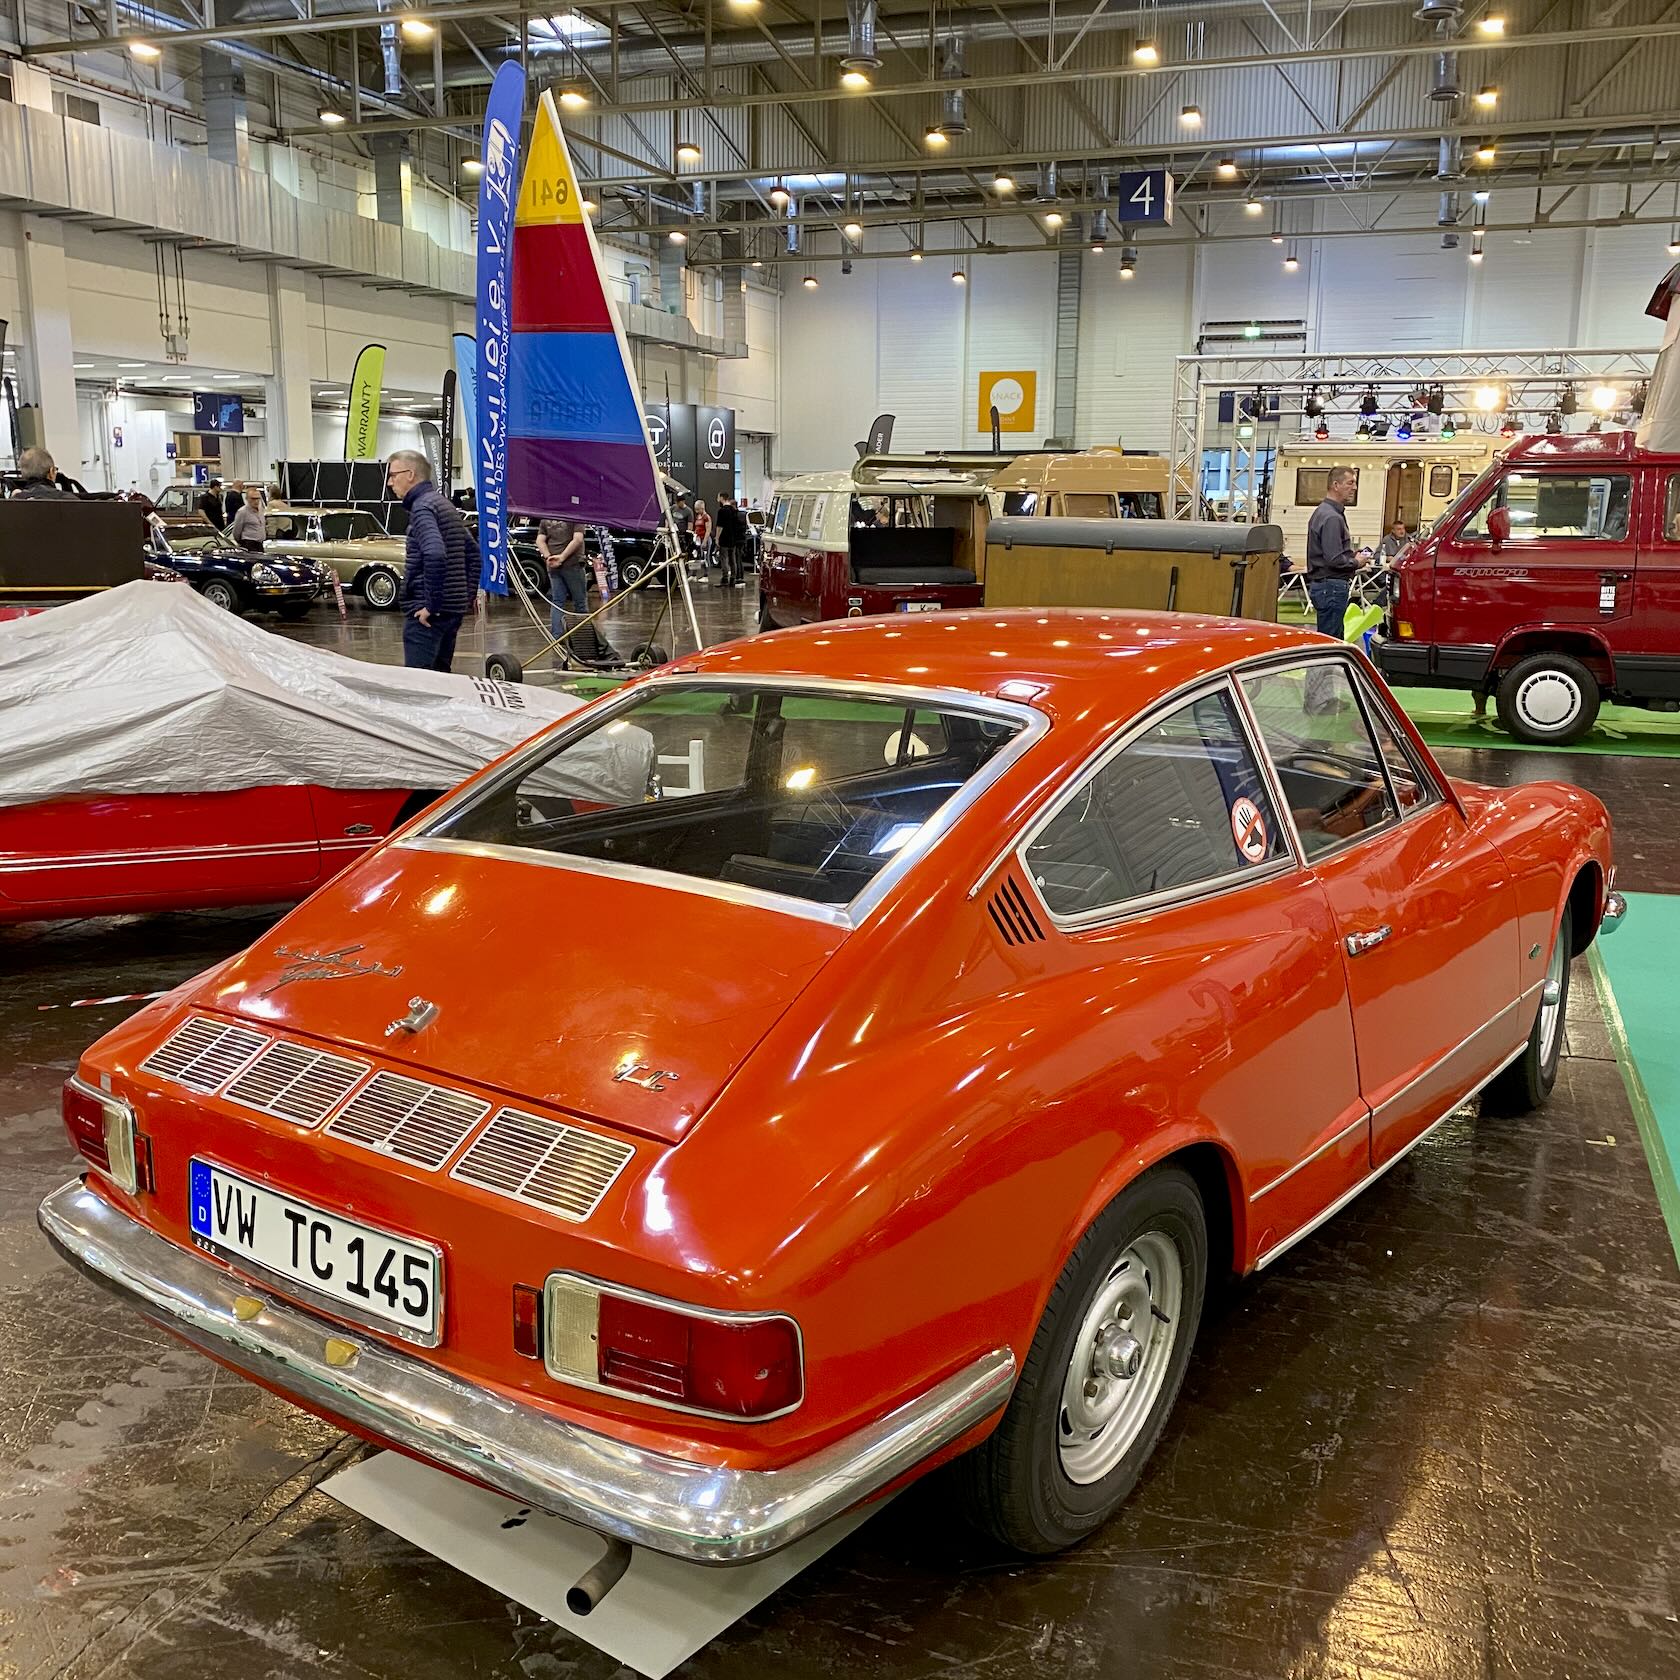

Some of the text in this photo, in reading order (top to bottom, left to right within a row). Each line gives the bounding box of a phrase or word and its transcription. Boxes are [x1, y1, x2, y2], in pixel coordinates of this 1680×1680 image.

[1129, 175, 1155, 216] 4
[195, 395, 204, 412] 5
[991, 391, 1022, 401] SNACK
[356, 380, 372, 458] WARRANTY
[200, 468, 208, 483] 5
[493, 453, 506, 483] DES
[198, 1206, 207, 1222] D
[213, 1178, 257, 1249] VW
[346, 1236, 430, 1318] 145
